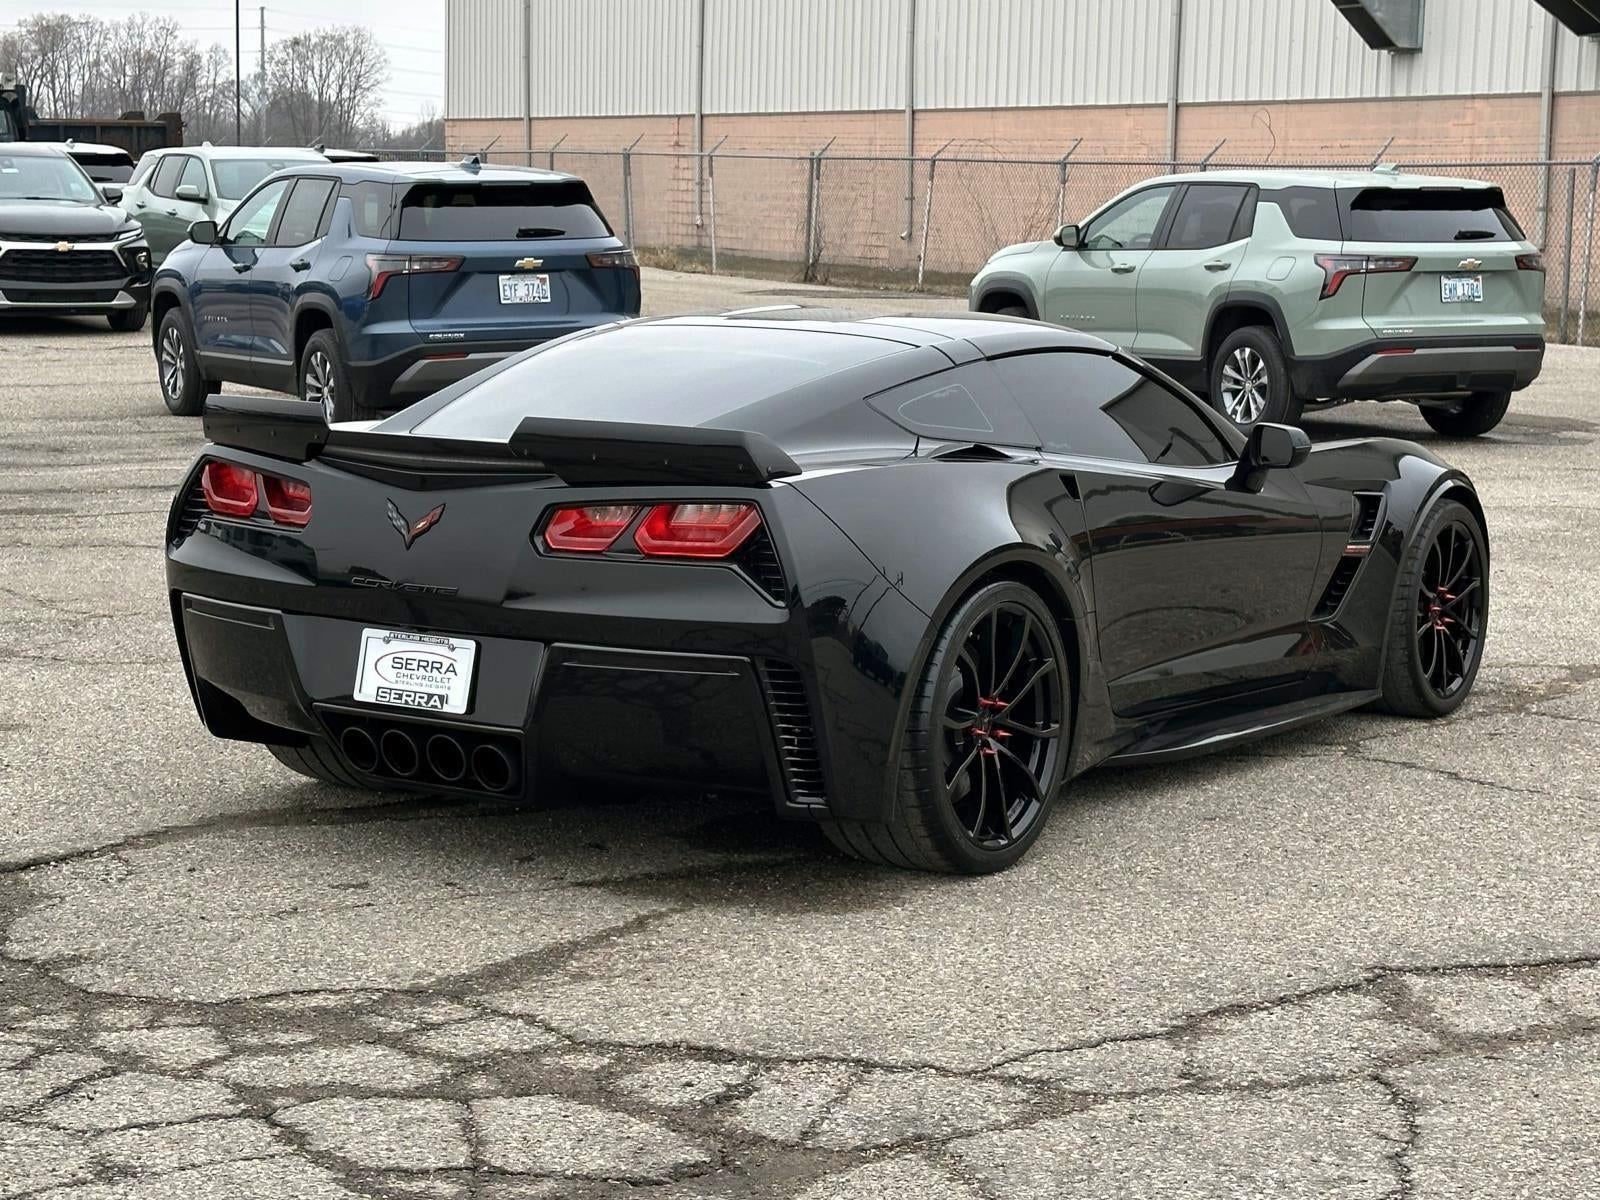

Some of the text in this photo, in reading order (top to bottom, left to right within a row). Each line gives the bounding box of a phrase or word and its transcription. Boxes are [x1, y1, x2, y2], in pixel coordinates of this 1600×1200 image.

[351, 577, 459, 595] CORVETTE
[389, 632, 449, 645] STERLING HEIGHTS
[391, 656, 458, 676] SERRA
[394, 679, 451, 691] STERLING HEIGHTS
[396, 672, 452, 684] CHEVROLET
[376, 687, 443, 709] SERRA
